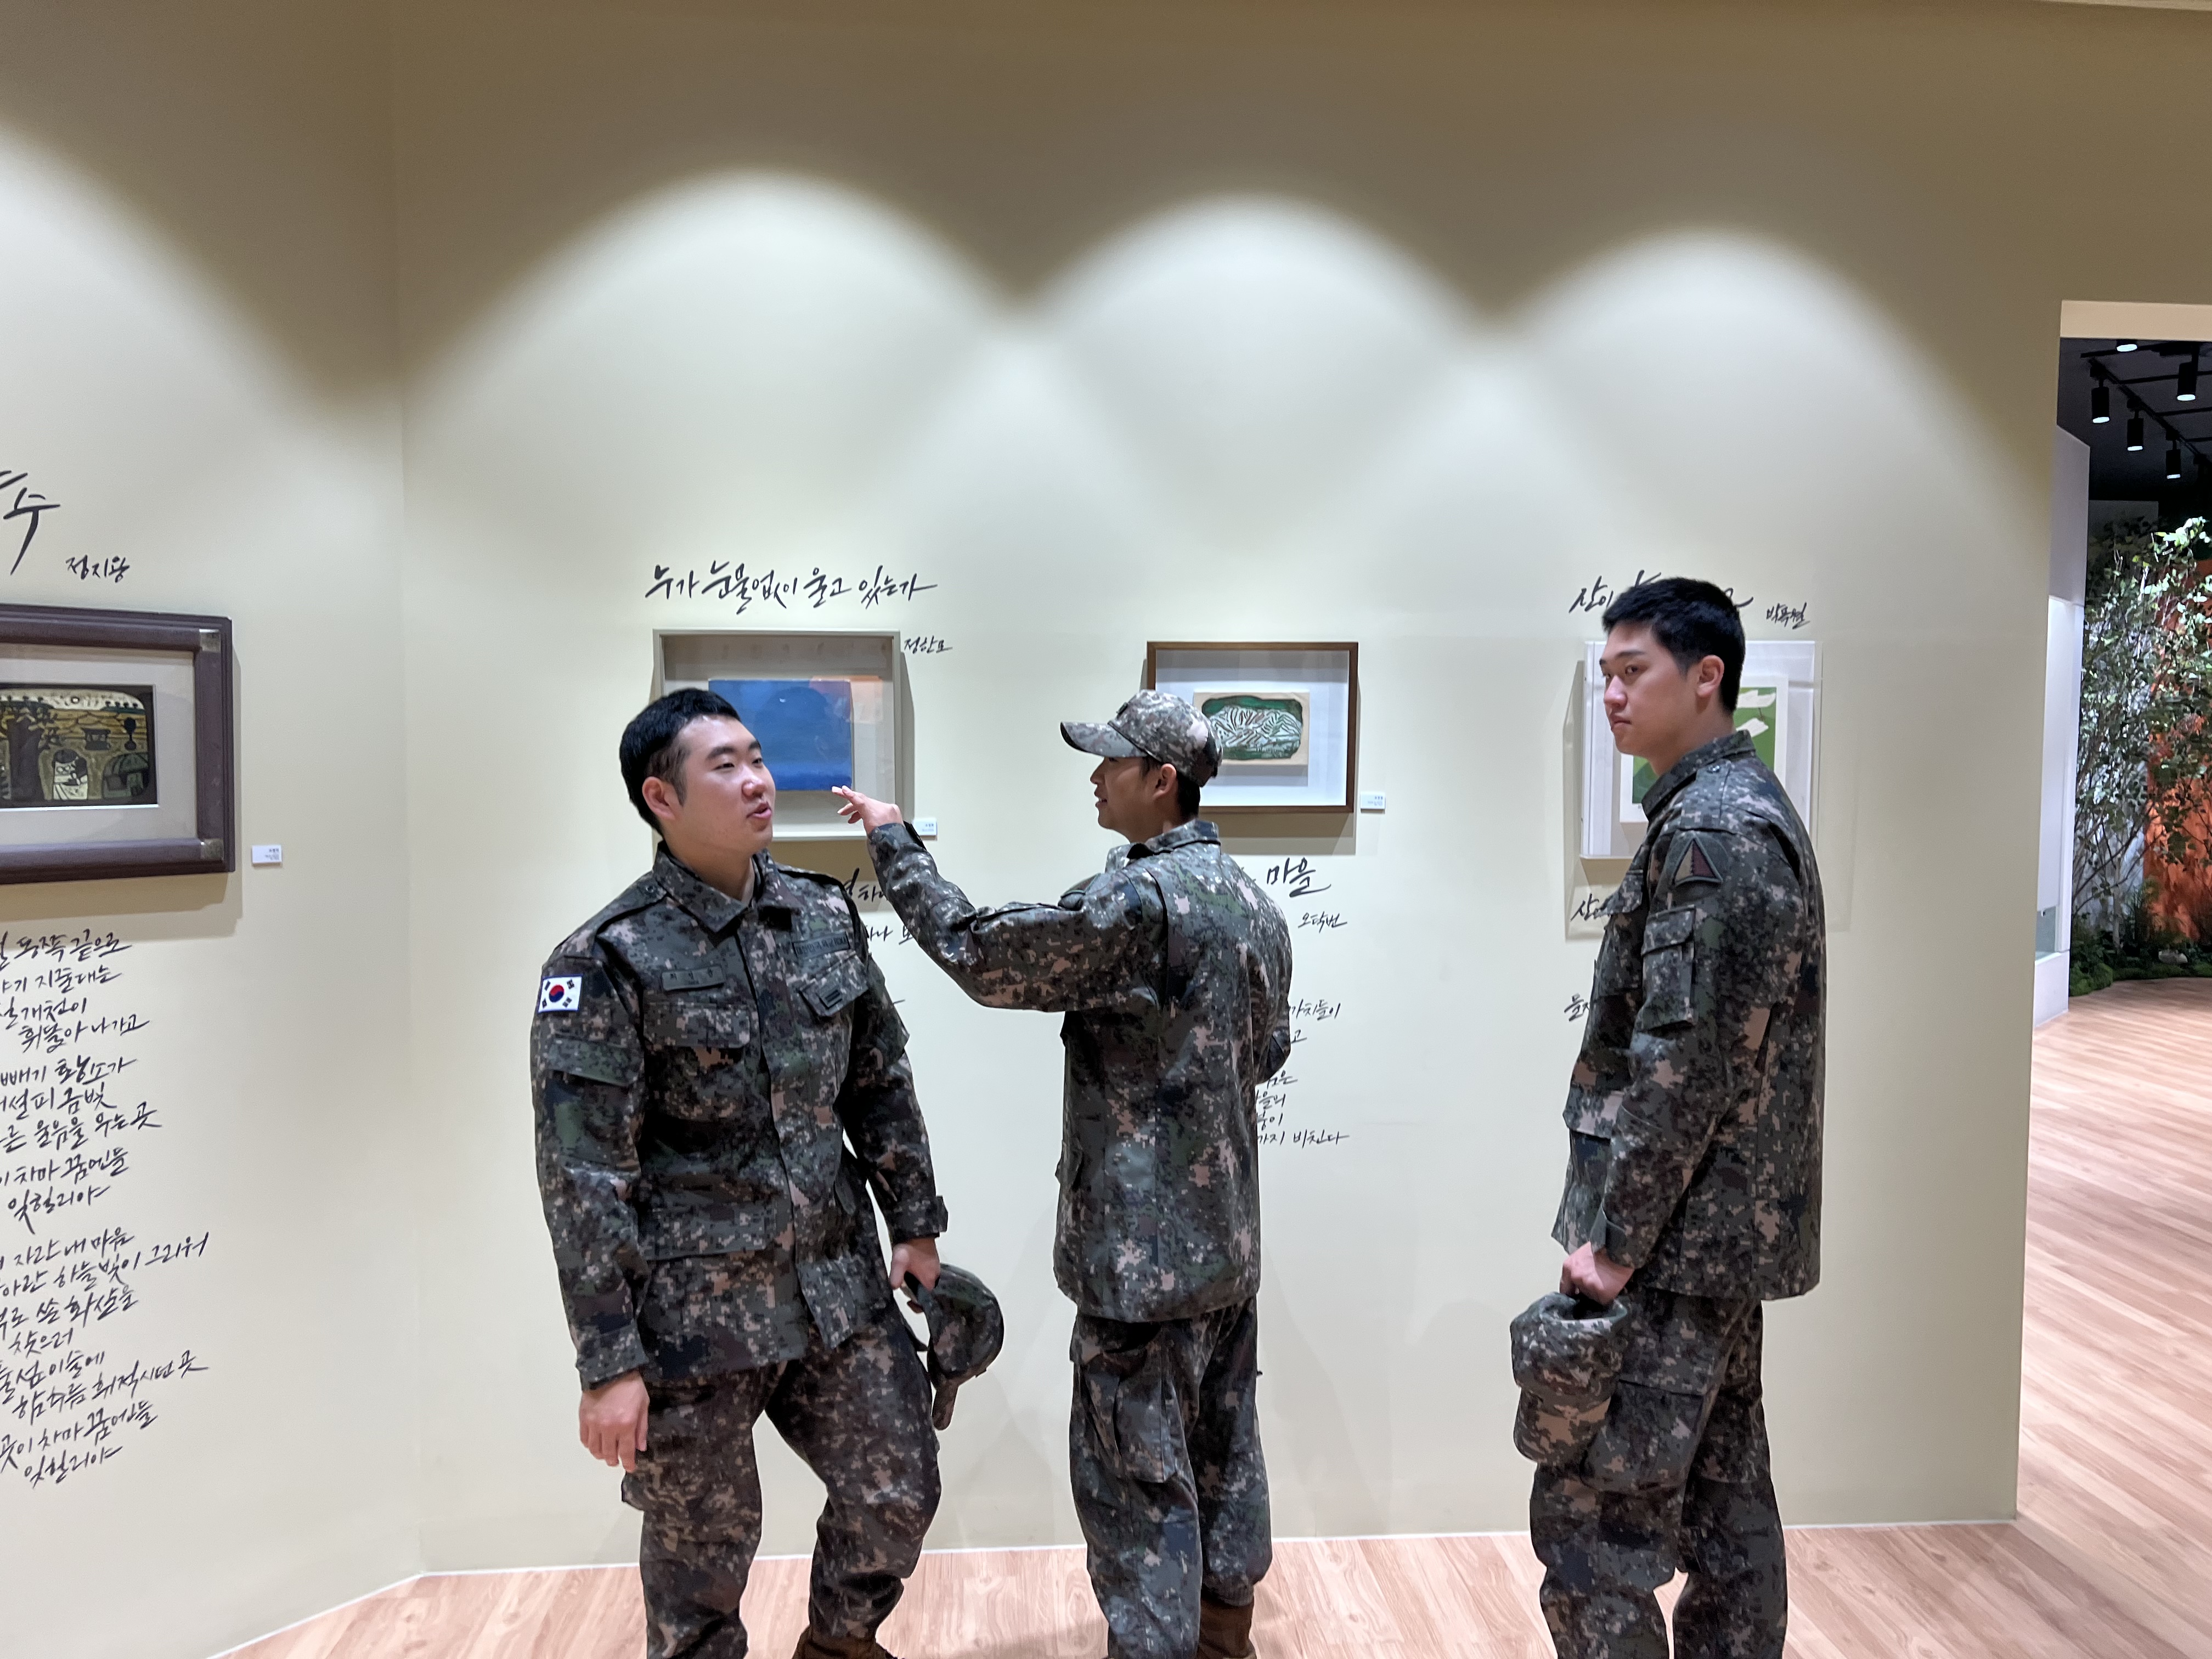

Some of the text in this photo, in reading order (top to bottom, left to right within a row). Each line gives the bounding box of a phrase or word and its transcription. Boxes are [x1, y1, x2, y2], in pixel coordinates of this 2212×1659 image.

[65, 554, 131, 583] 정지용
[645, 564, 701, 600] 누가
[803, 567, 852, 609] 울고
[859, 565, 938, 610] 있는가
[1267, 857, 1331, 898] 마을
[14, 934, 67, 962] 동쪽
[70, 928, 132, 962] 끝으로
[35, 964, 122, 994] 지줄대는
[54, 1054, 137, 1085] 황소가
[57, 1082, 117, 1115] 금빛
[34, 1116, 88, 1150] 울음을
[94, 1111, 129, 1137] 우는
[129, 1101, 162, 1131] 곳
[1293, 1128, 1350, 1149] 비친다
[14, 1159, 61, 1184] 차마
[60, 1147, 129, 1184] 꿈엔들
[14, 1238, 62, 1266] 자란
[64, 1237, 86, 1256] 내
[91, 1226, 135, 1258] 마음
[0, 1269, 48, 1297] 아란
[145, 1232, 210, 1266] 그리워
[64, 1284, 139, 1328] 화살을
[8, 1328, 74, 1359] 찾으러
[49, 1350, 105, 1379] 이슬에
[178, 1350, 210, 1379] 곳
[37, 1422, 84, 1451] 차마
[84, 1400, 158, 1446] 꿈엔들
